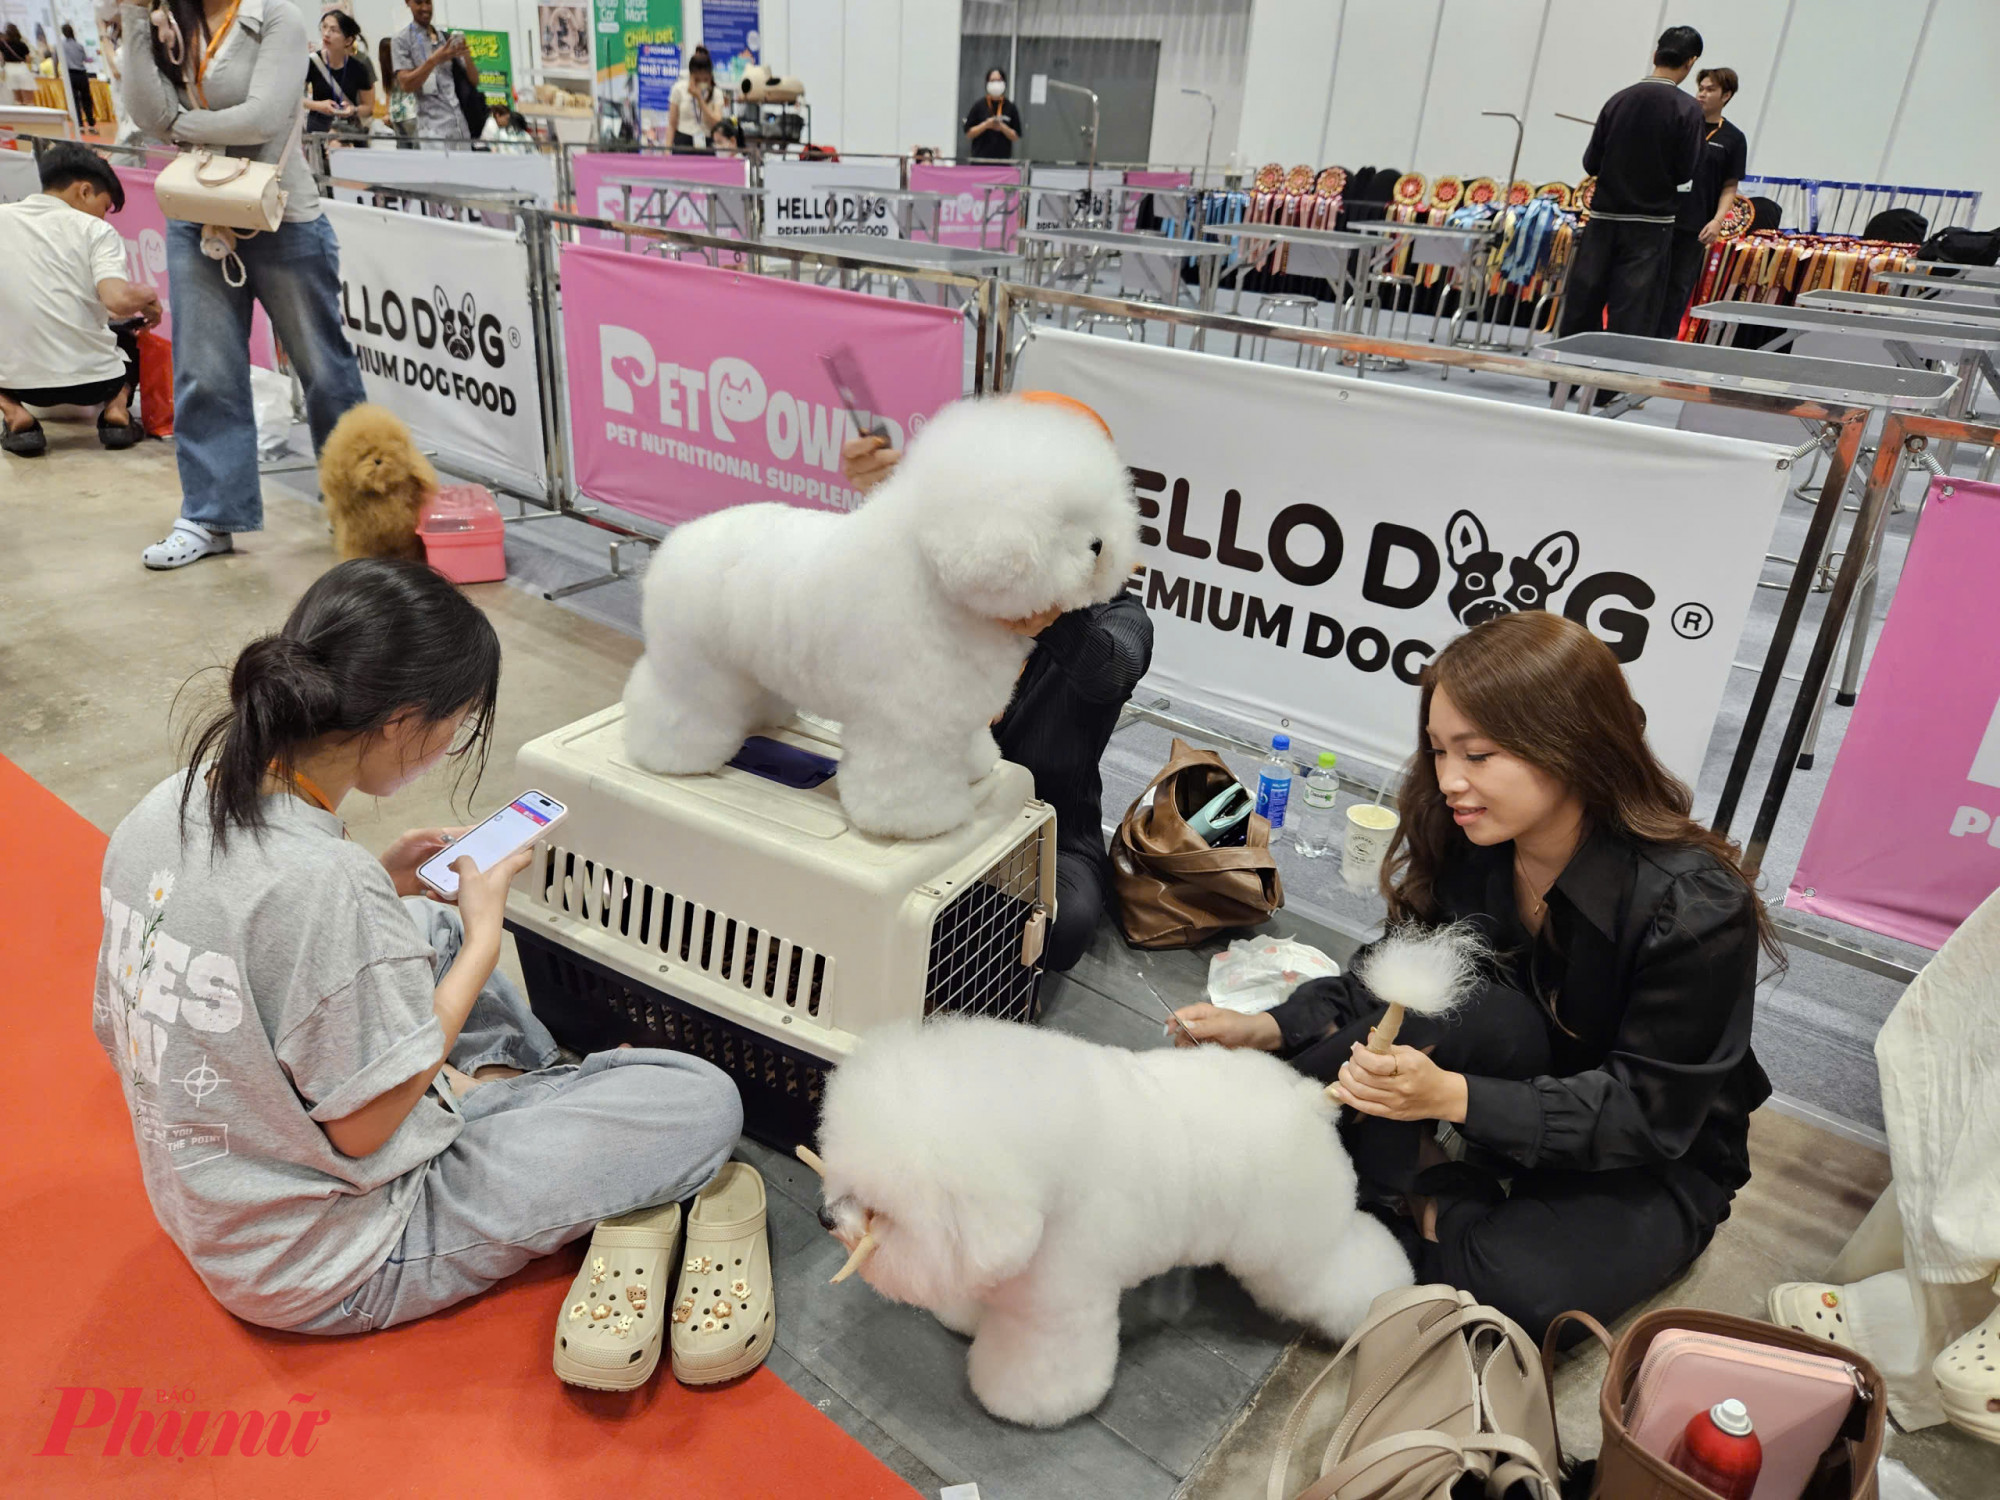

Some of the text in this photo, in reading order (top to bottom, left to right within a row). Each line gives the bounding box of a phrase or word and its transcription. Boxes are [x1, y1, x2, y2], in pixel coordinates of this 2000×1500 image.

[777, 197, 838, 219] HELLO
[342, 281, 407, 341] LLO
[404, 357, 450, 396] DOG
[452, 372, 516, 416] FOOD
[606, 421, 866, 510] PET NUTRITIONAL SUPPLEM
[1126, 465, 1344, 586] ELLO
[1122, 565, 1294, 649] EMIUM
[167, 1138, 186, 1151] THE
